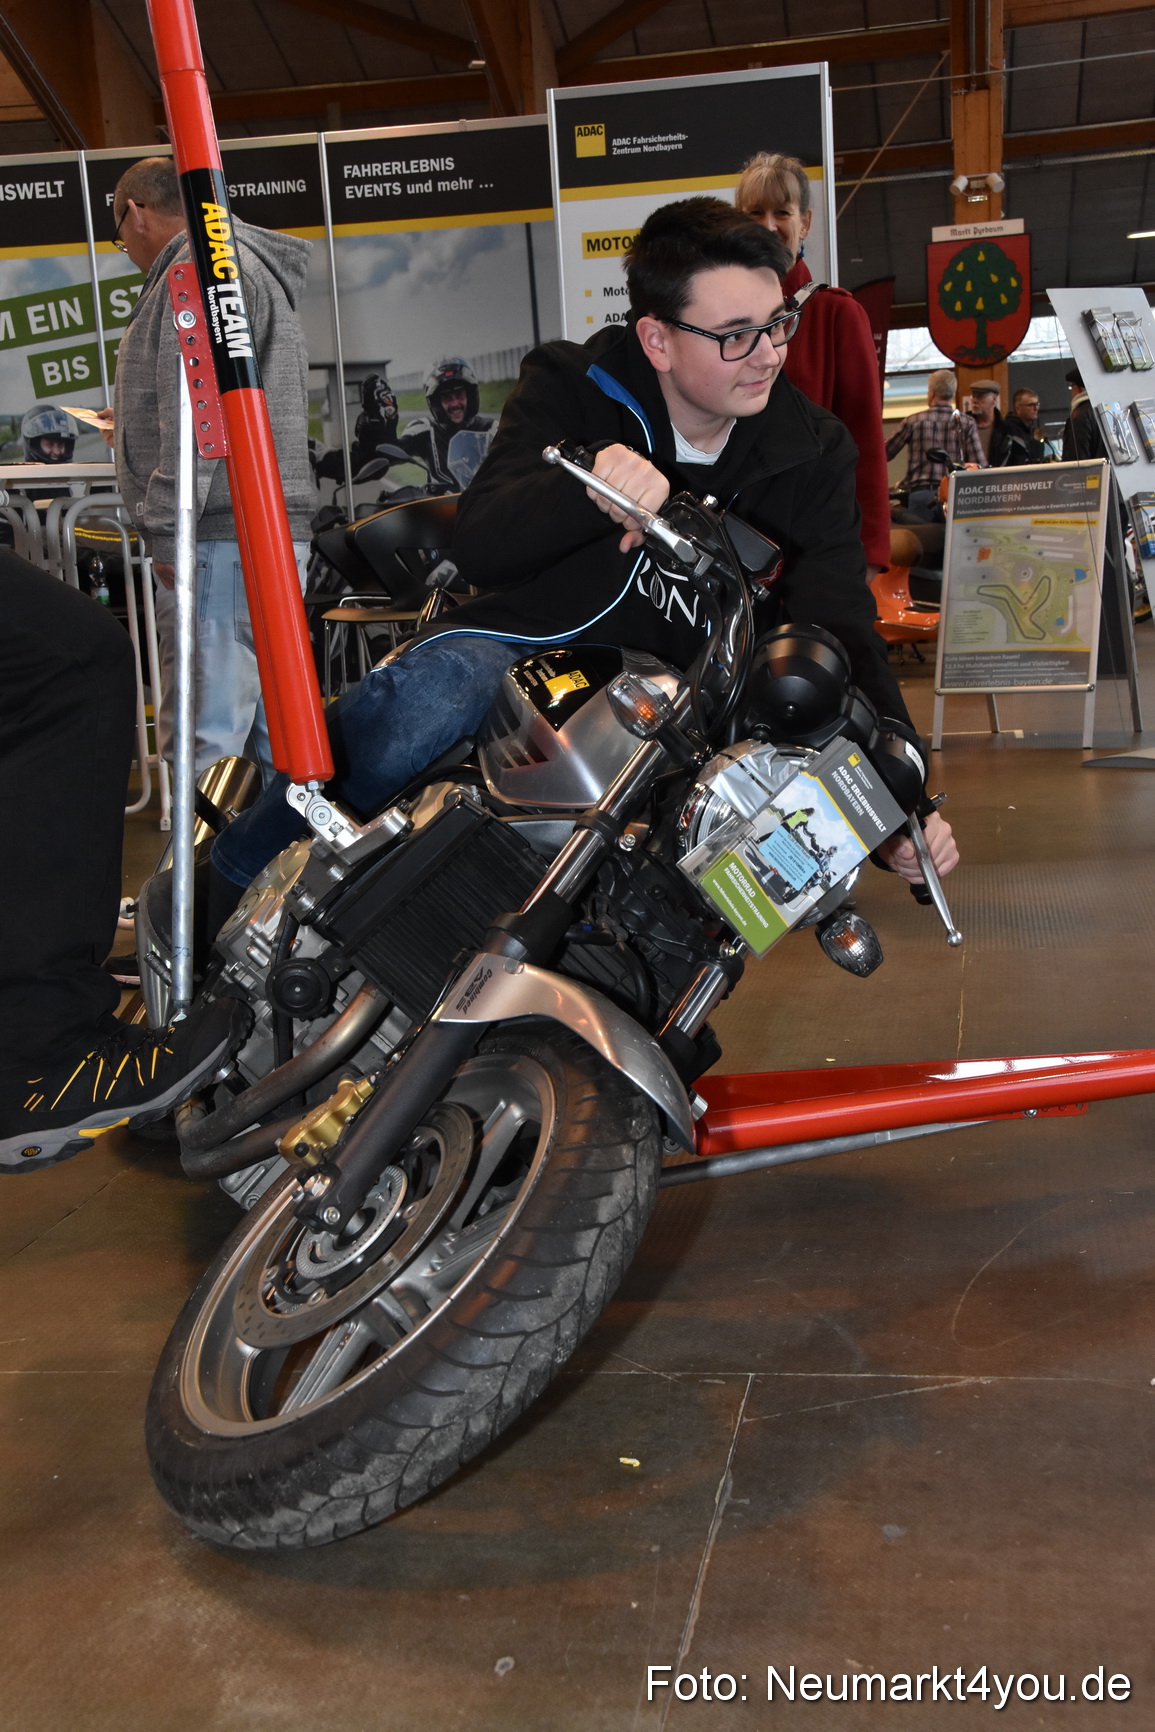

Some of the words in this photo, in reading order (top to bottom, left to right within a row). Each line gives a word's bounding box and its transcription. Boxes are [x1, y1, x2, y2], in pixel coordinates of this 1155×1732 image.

[577, 125, 603, 138] ADAC
[612, 138, 631, 147] ADAC
[633, 133, 688, 145] Fahrsicherheits-
[612, 145, 641, 155] Zentrum
[643, 143, 682, 153] Nordbayern
[343, 157, 455, 178] FAHRERLEBNIS
[345, 182, 402, 199] EVENTS
[407, 180, 432, 194] und
[437, 177, 473, 192] mehr
[201, 202, 239, 280] ADAC
[26, 297, 84, 335] EIN
[206, 285, 222, 345] Nordbayern
[216, 278, 254, 359] TEAM
[41, 355, 90, 386] BIS
[957, 493, 1022, 506] NORDBAYERN
[958, 485, 983, 496] ADAC
[985, 481, 1053, 493] ERLEBNISWELT
[567, 671, 588, 689] ADAC
[831, 770, 865, 817] NORDBAYERN
[838, 765, 854, 785] ADAC
[850, 783, 887, 833] ERLEBNISWELT
[728, 861, 756, 898] MOTORRAD
[462, 968, 493, 1015] Combined
